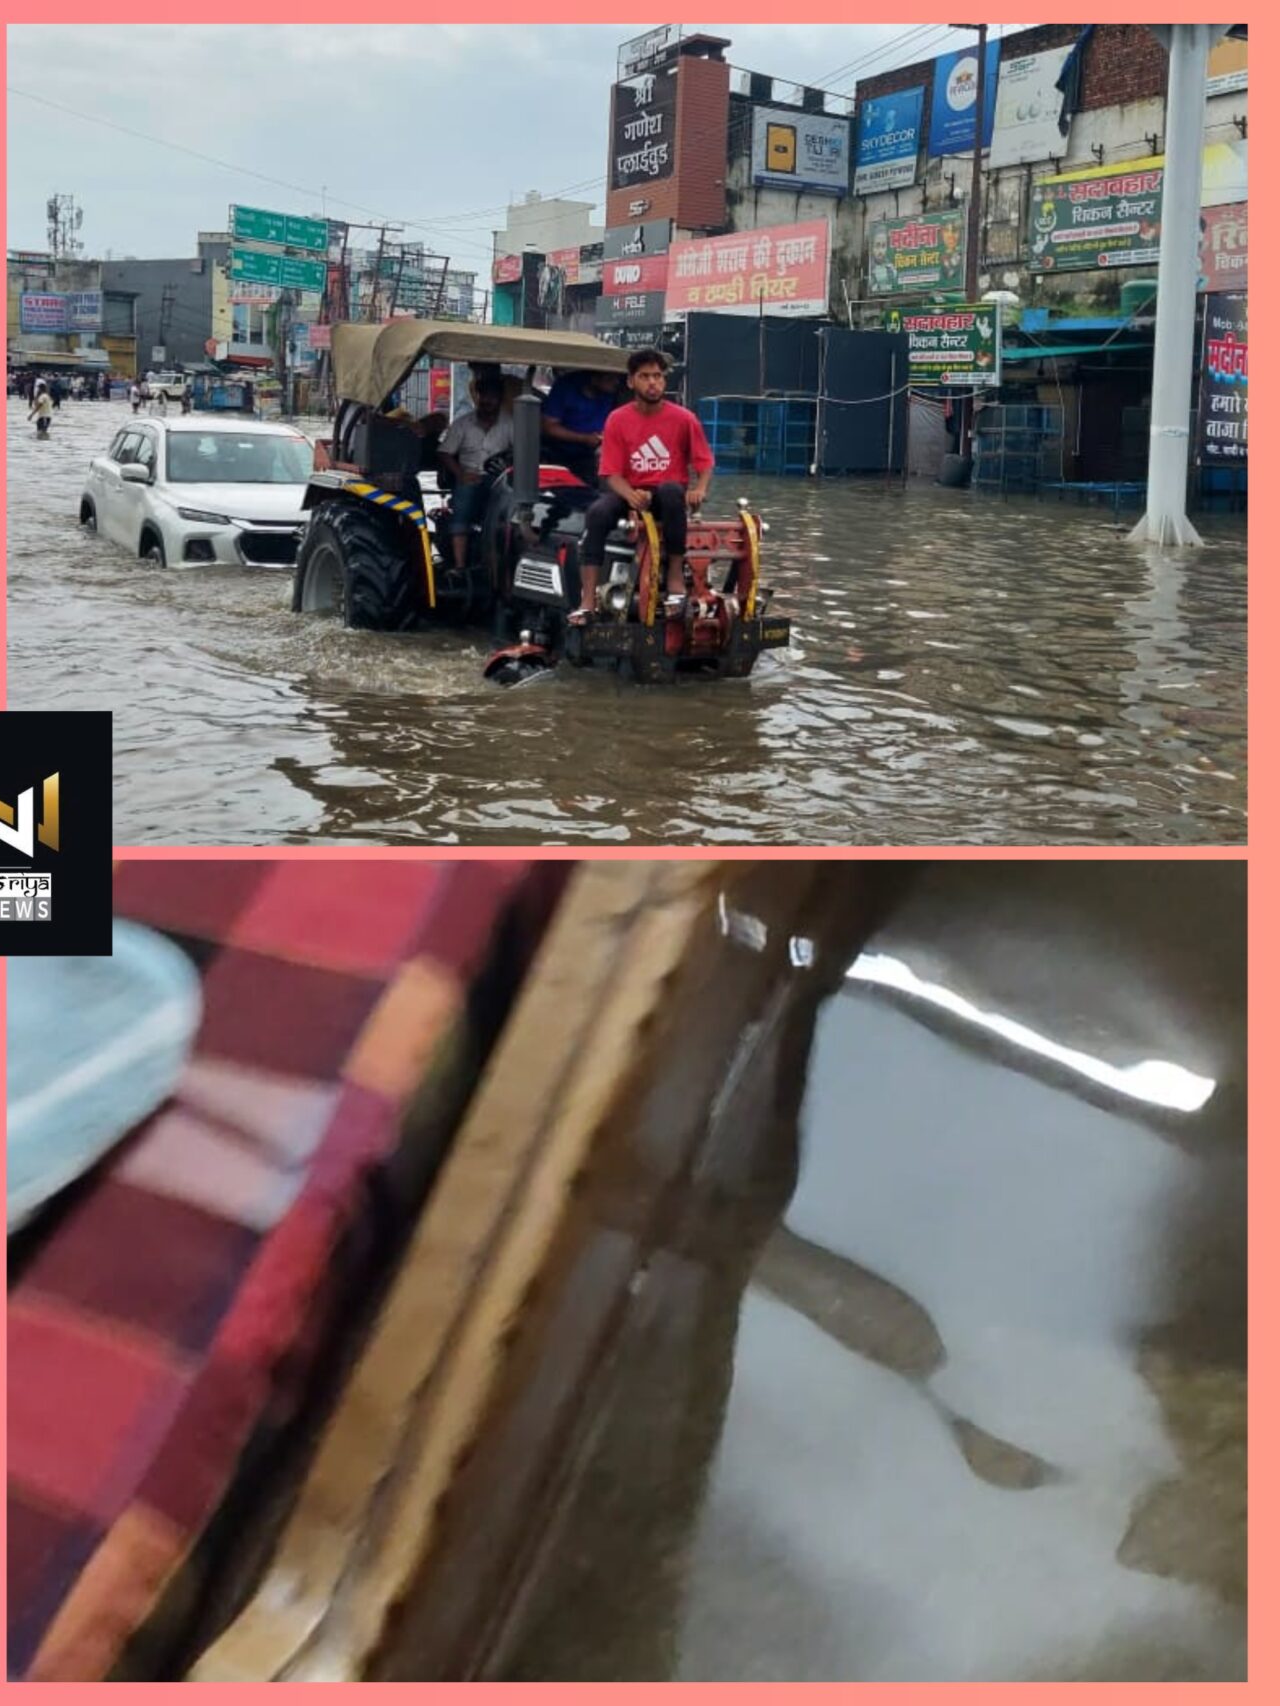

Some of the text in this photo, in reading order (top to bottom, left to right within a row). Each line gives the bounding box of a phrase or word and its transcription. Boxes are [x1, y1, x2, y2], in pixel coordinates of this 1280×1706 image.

[624, 111, 663, 141] गणेश
[617, 142, 669, 175] प्लाईवुड
[1069, 170, 1162, 204] सदाबहार
[1072, 206, 1113, 224] चिकन
[1211, 391, 1241, 414] हमारे
[1206, 419, 1240, 440] ताजा
